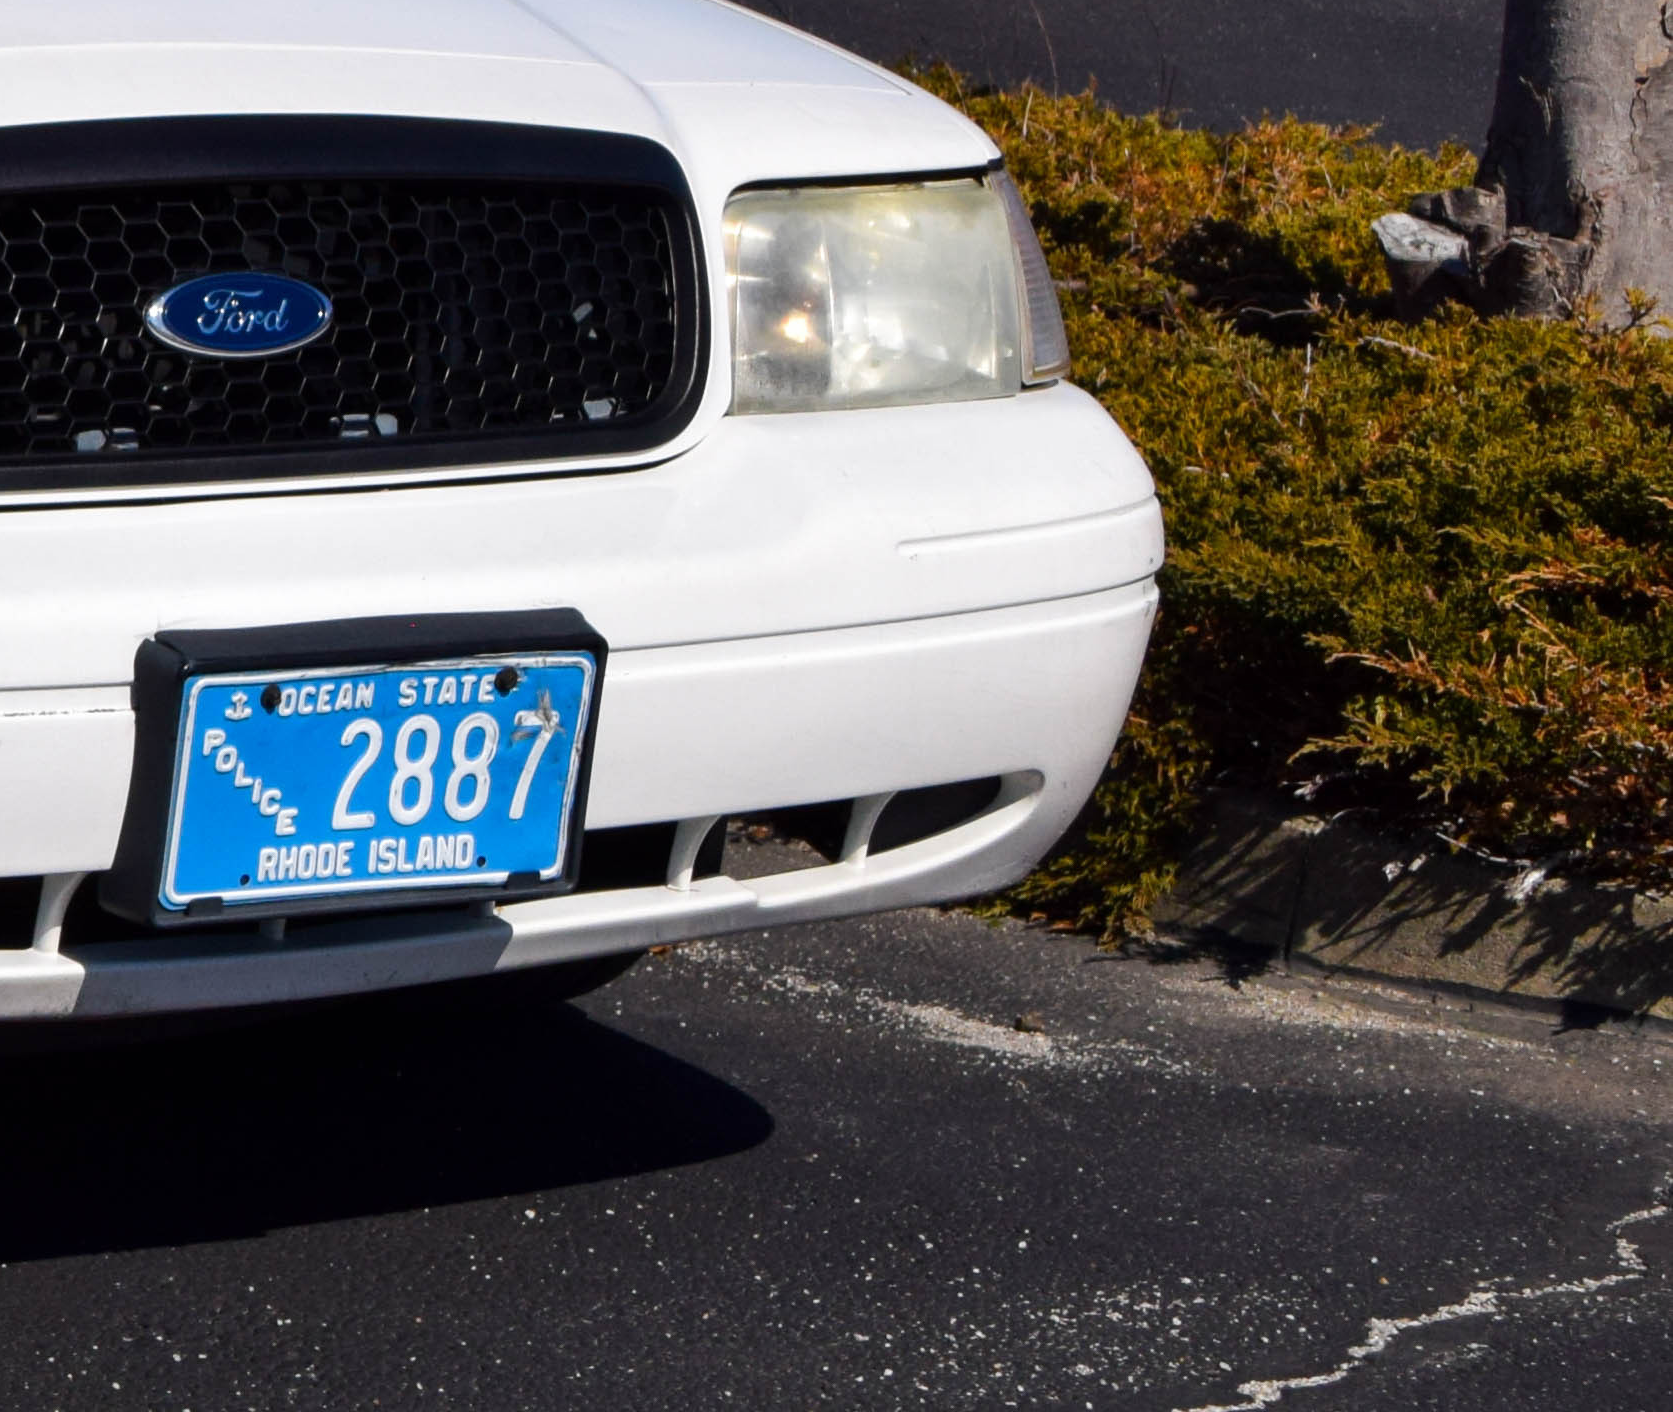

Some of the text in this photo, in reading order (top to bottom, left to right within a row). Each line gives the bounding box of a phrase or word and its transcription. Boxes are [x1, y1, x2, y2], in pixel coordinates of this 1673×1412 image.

[197, 289, 290, 334] Ford
[277, 674, 495, 717] OCEAN STATE
[202, 728, 299, 837] POLICE
[331, 709, 560, 831] 2887
[257, 833, 475, 884] RHODE ISLAND
